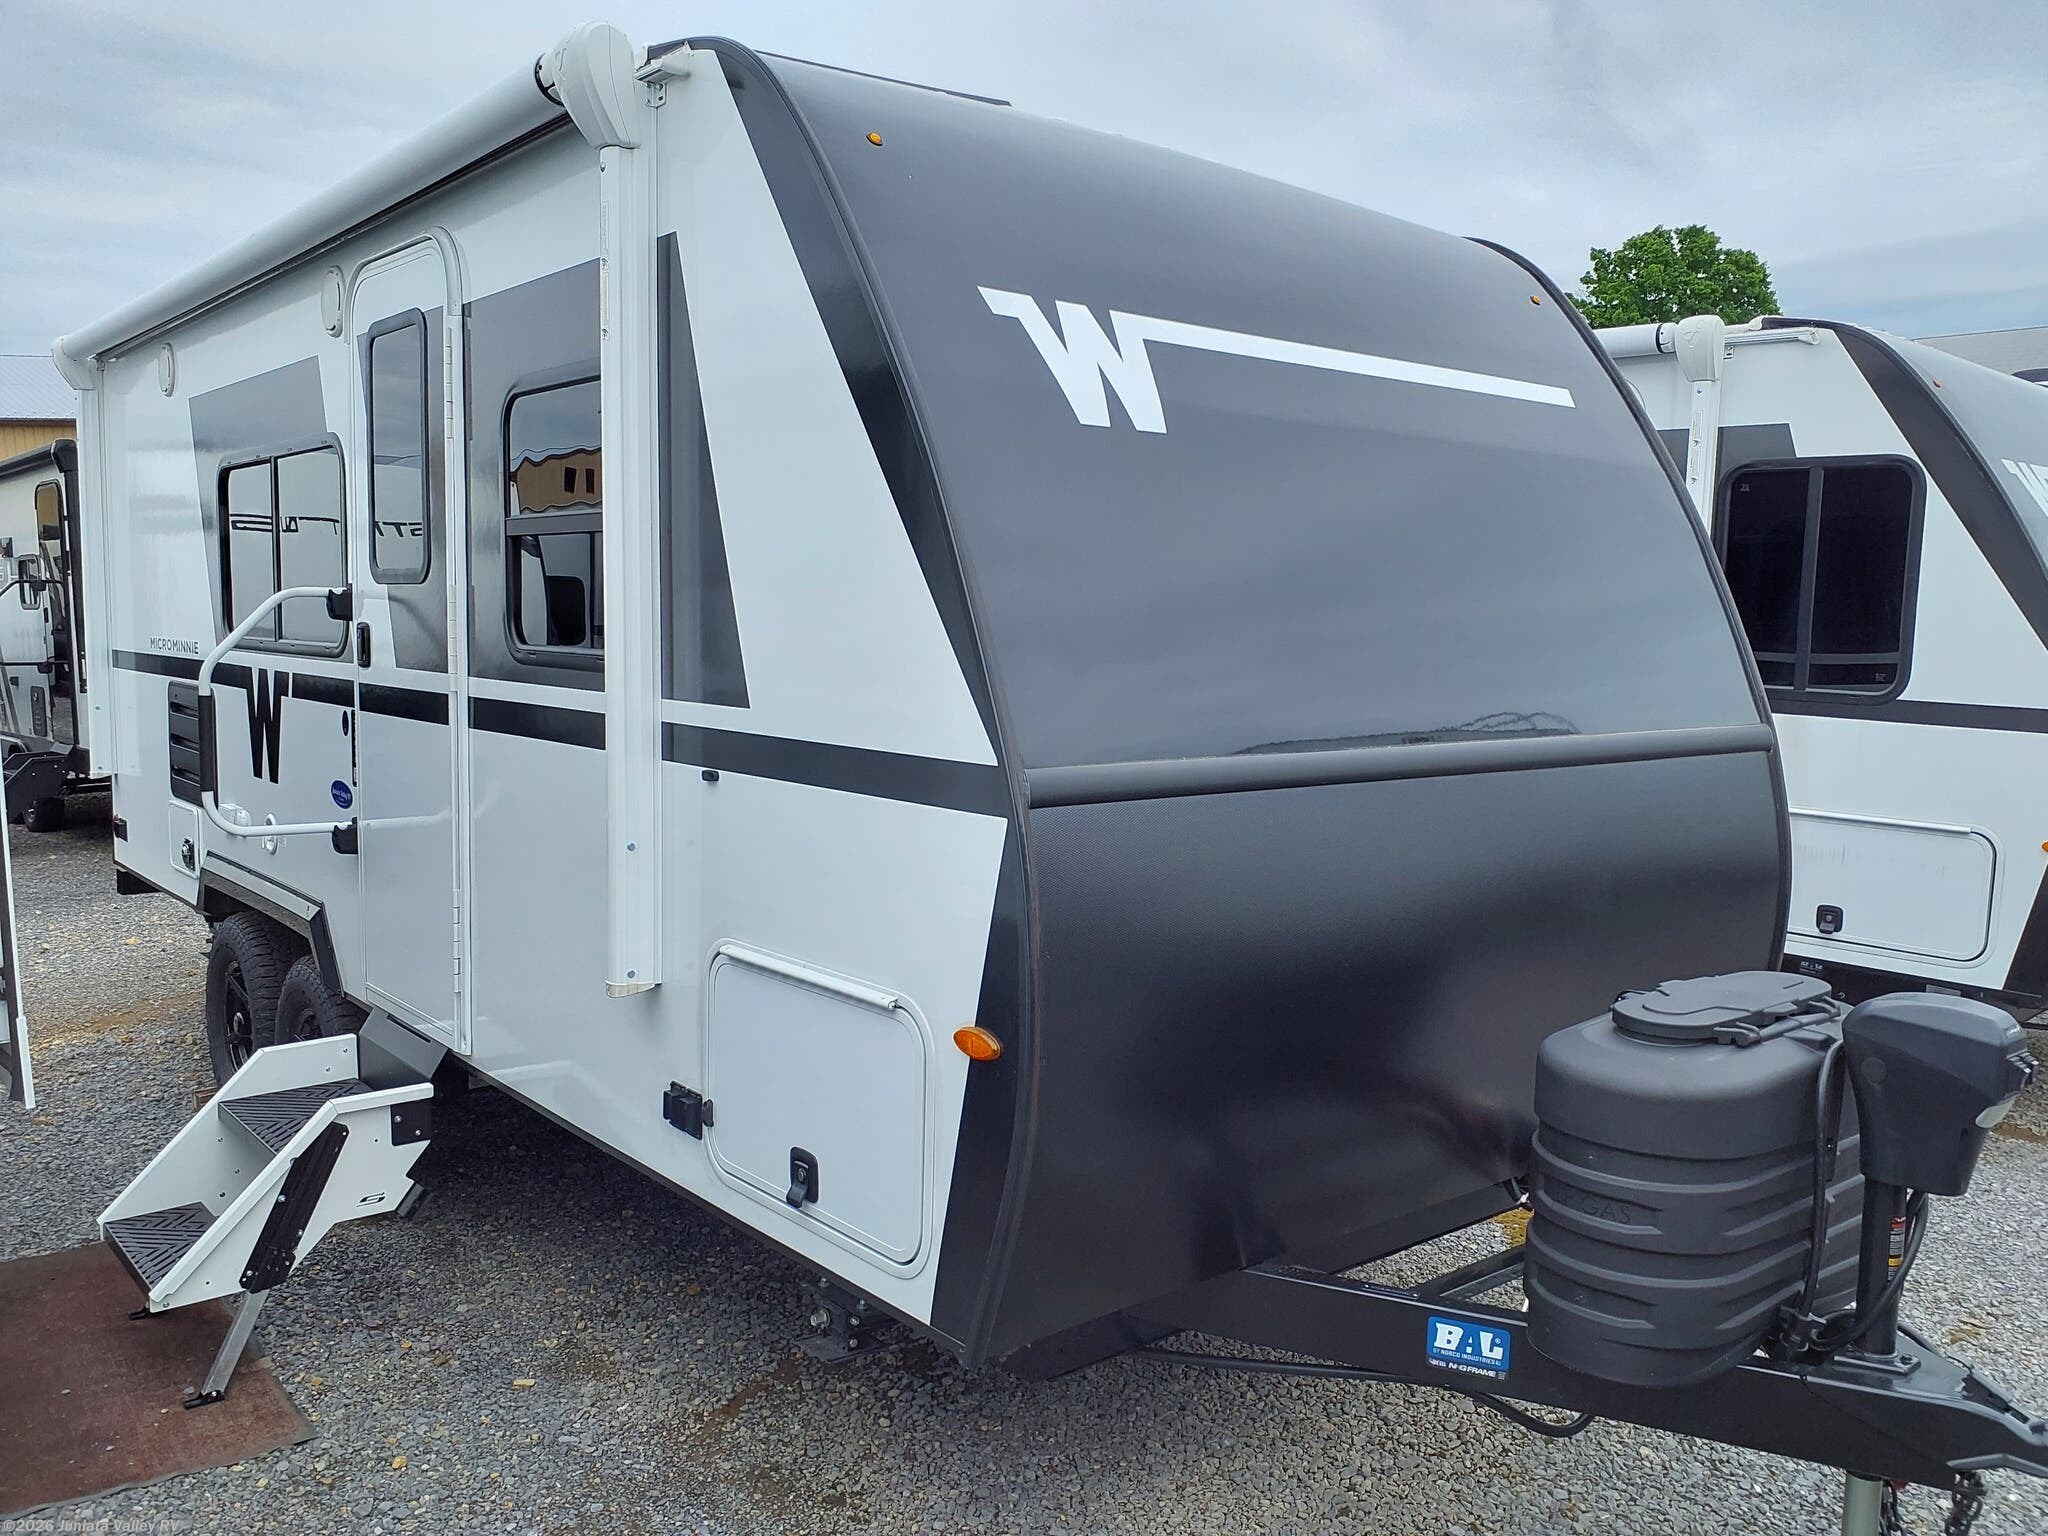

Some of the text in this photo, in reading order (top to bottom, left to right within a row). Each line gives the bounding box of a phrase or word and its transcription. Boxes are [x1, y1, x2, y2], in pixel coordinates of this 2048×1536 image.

[150, 637, 199, 655] MICROMINNIE
[1581, 1197, 1631, 1224] GAS
[1440, 1349, 1461, 1358] NORCO
[1461, 1353, 1496, 1365] INDUSTRIES
